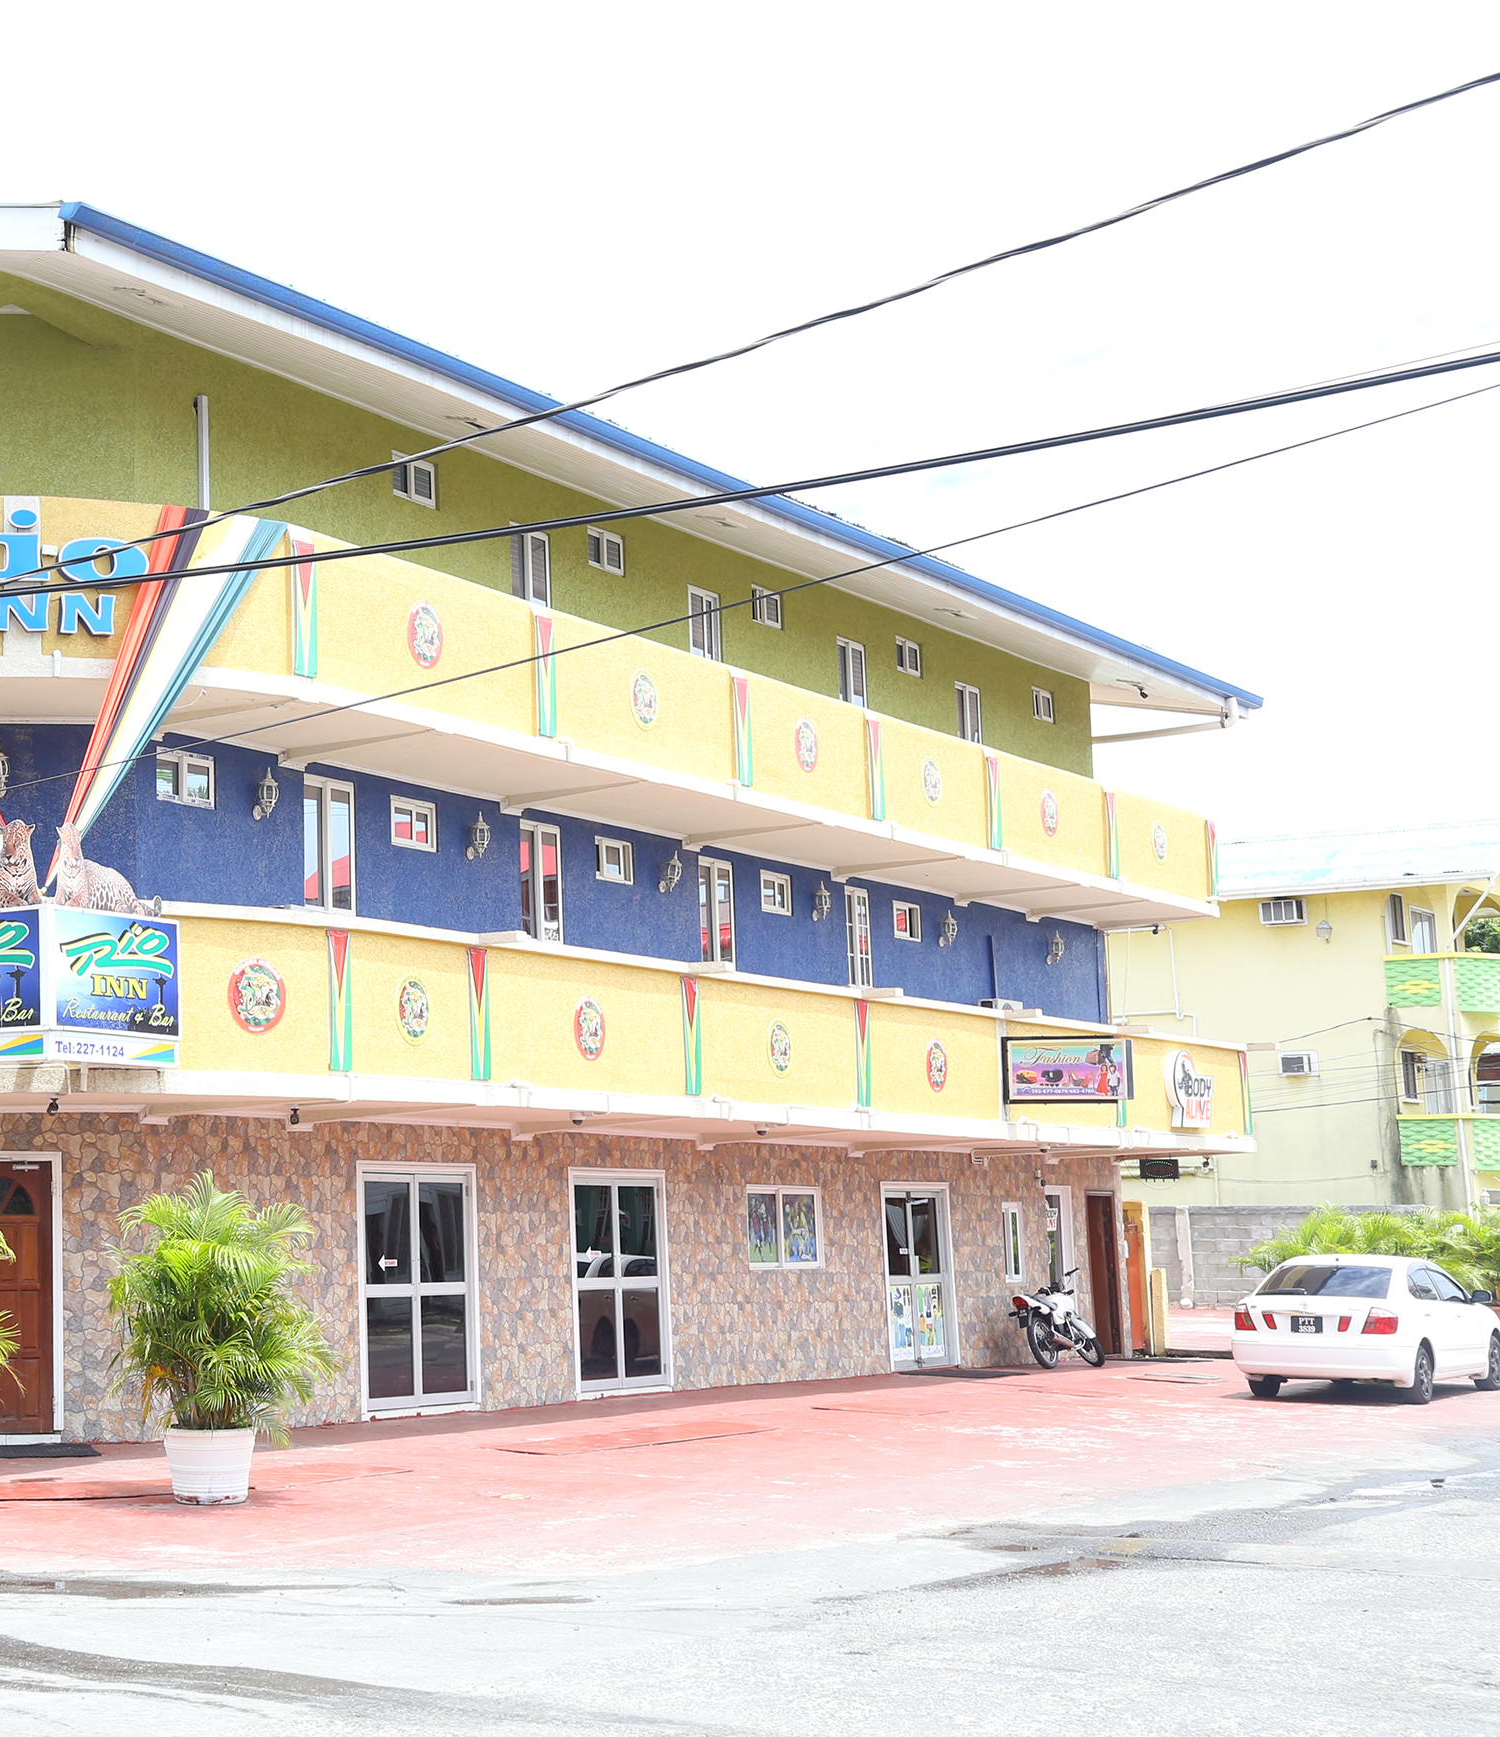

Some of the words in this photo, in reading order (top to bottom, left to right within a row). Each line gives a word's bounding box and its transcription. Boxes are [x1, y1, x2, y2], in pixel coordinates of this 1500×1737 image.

[91, 974, 148, 1000] INN
[0, 998, 35, 1022] Bar
[60, 997, 134, 1023] Restaurant
[148, 1004, 175, 1027] Bar
[76, 1043, 125, 1057] 227-1124
[1019, 1046, 1082, 1067] Fashion
[1186, 1078, 1211, 1097] BODY
[1186, 1099, 1210, 1120] ALIVE
